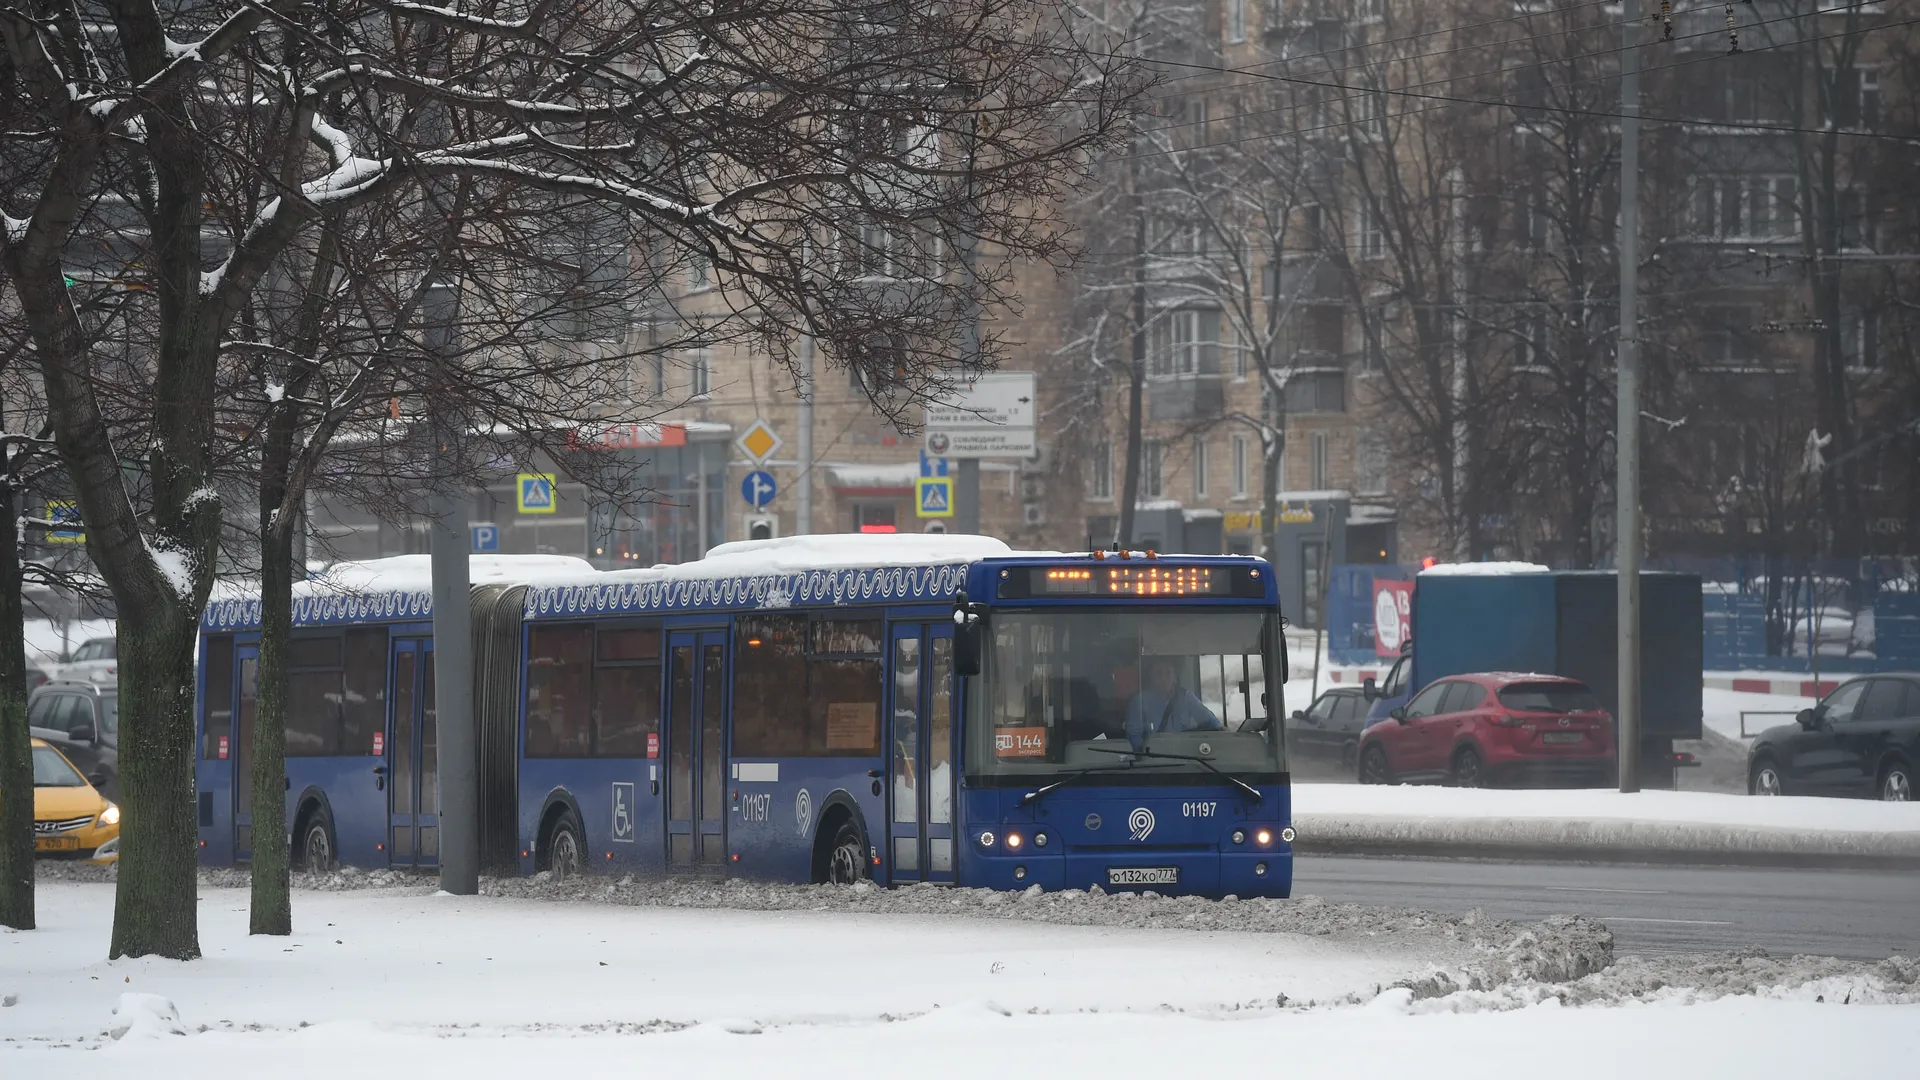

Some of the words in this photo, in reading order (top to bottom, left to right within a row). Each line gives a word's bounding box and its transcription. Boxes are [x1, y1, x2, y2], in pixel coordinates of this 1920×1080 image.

[478, 528, 492, 548] P
[1016, 735, 1041, 748] 144
[742, 793, 771, 821] 01197
[1182, 802, 1217, 817] 01197
